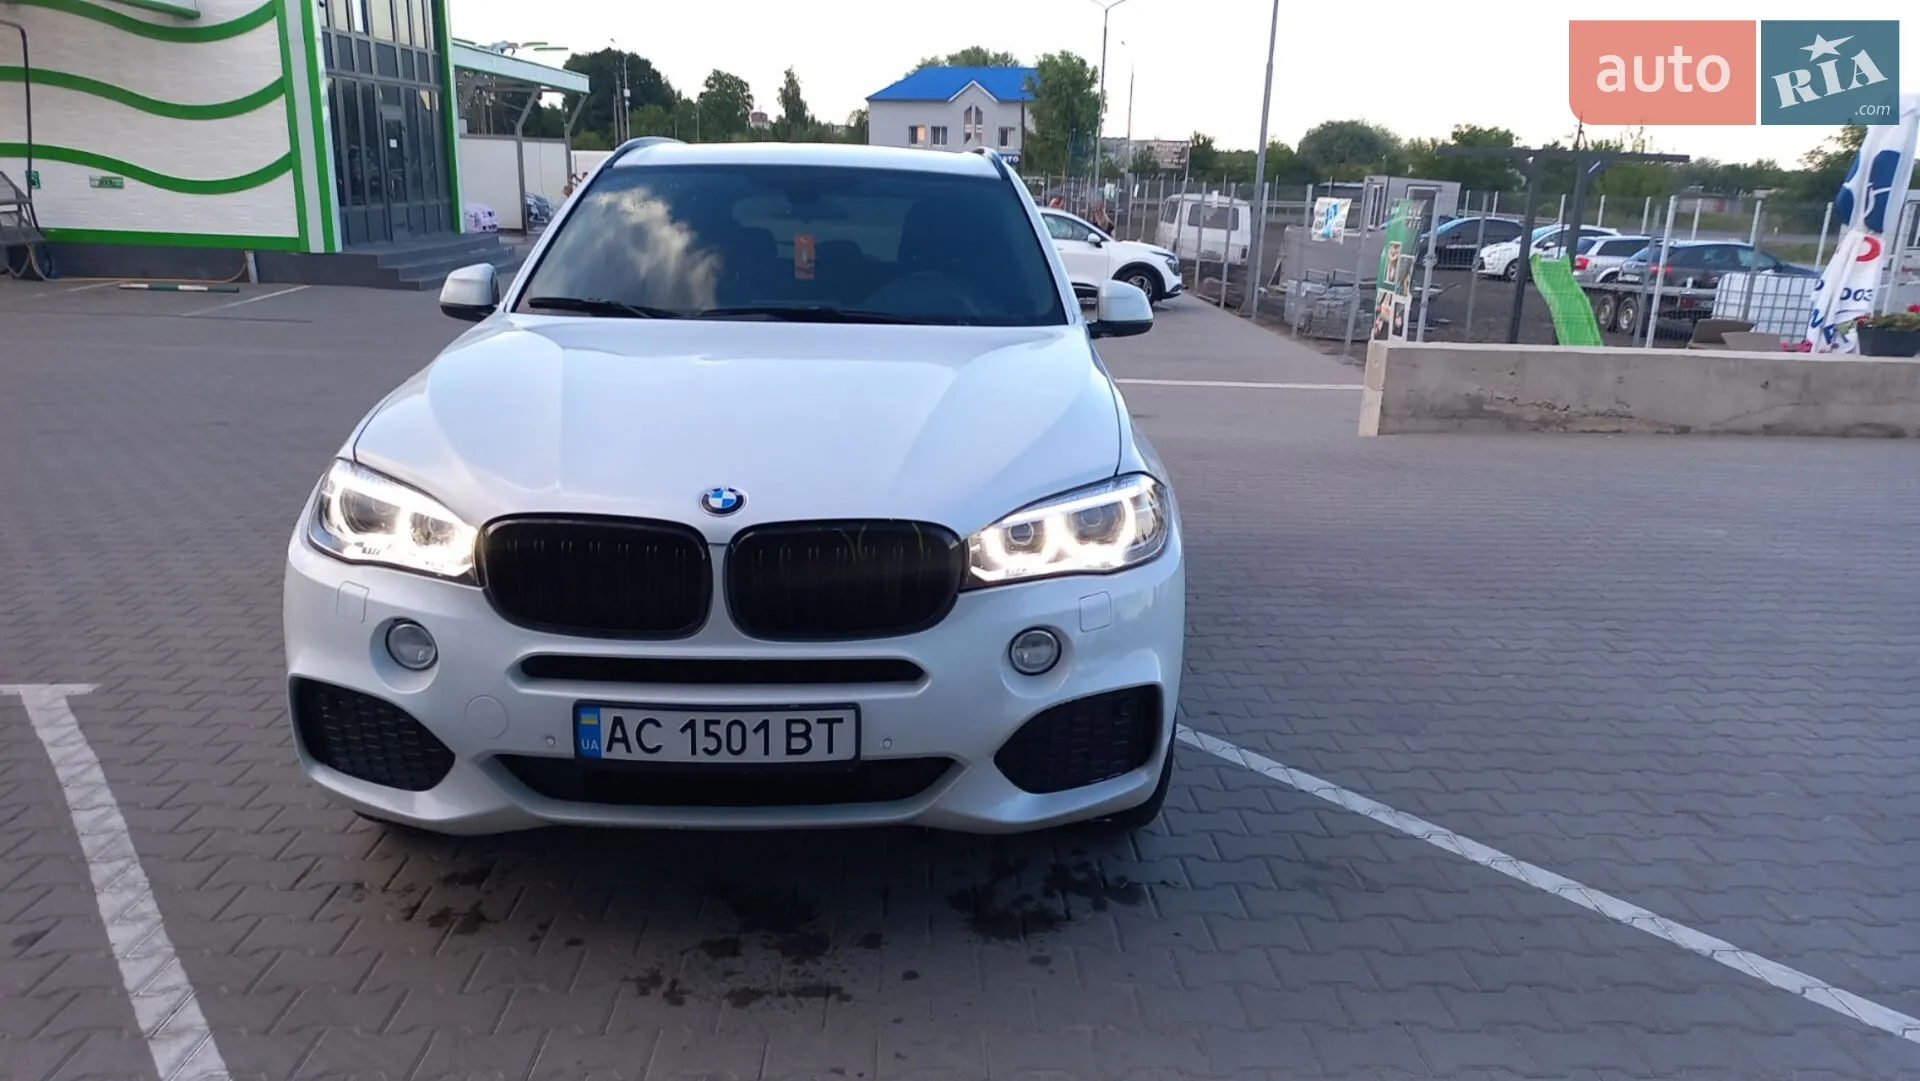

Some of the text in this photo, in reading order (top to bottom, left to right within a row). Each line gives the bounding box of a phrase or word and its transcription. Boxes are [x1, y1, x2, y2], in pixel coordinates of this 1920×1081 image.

[581, 737, 600, 752] UA
[606, 716, 844, 757] AC 1501 BT
